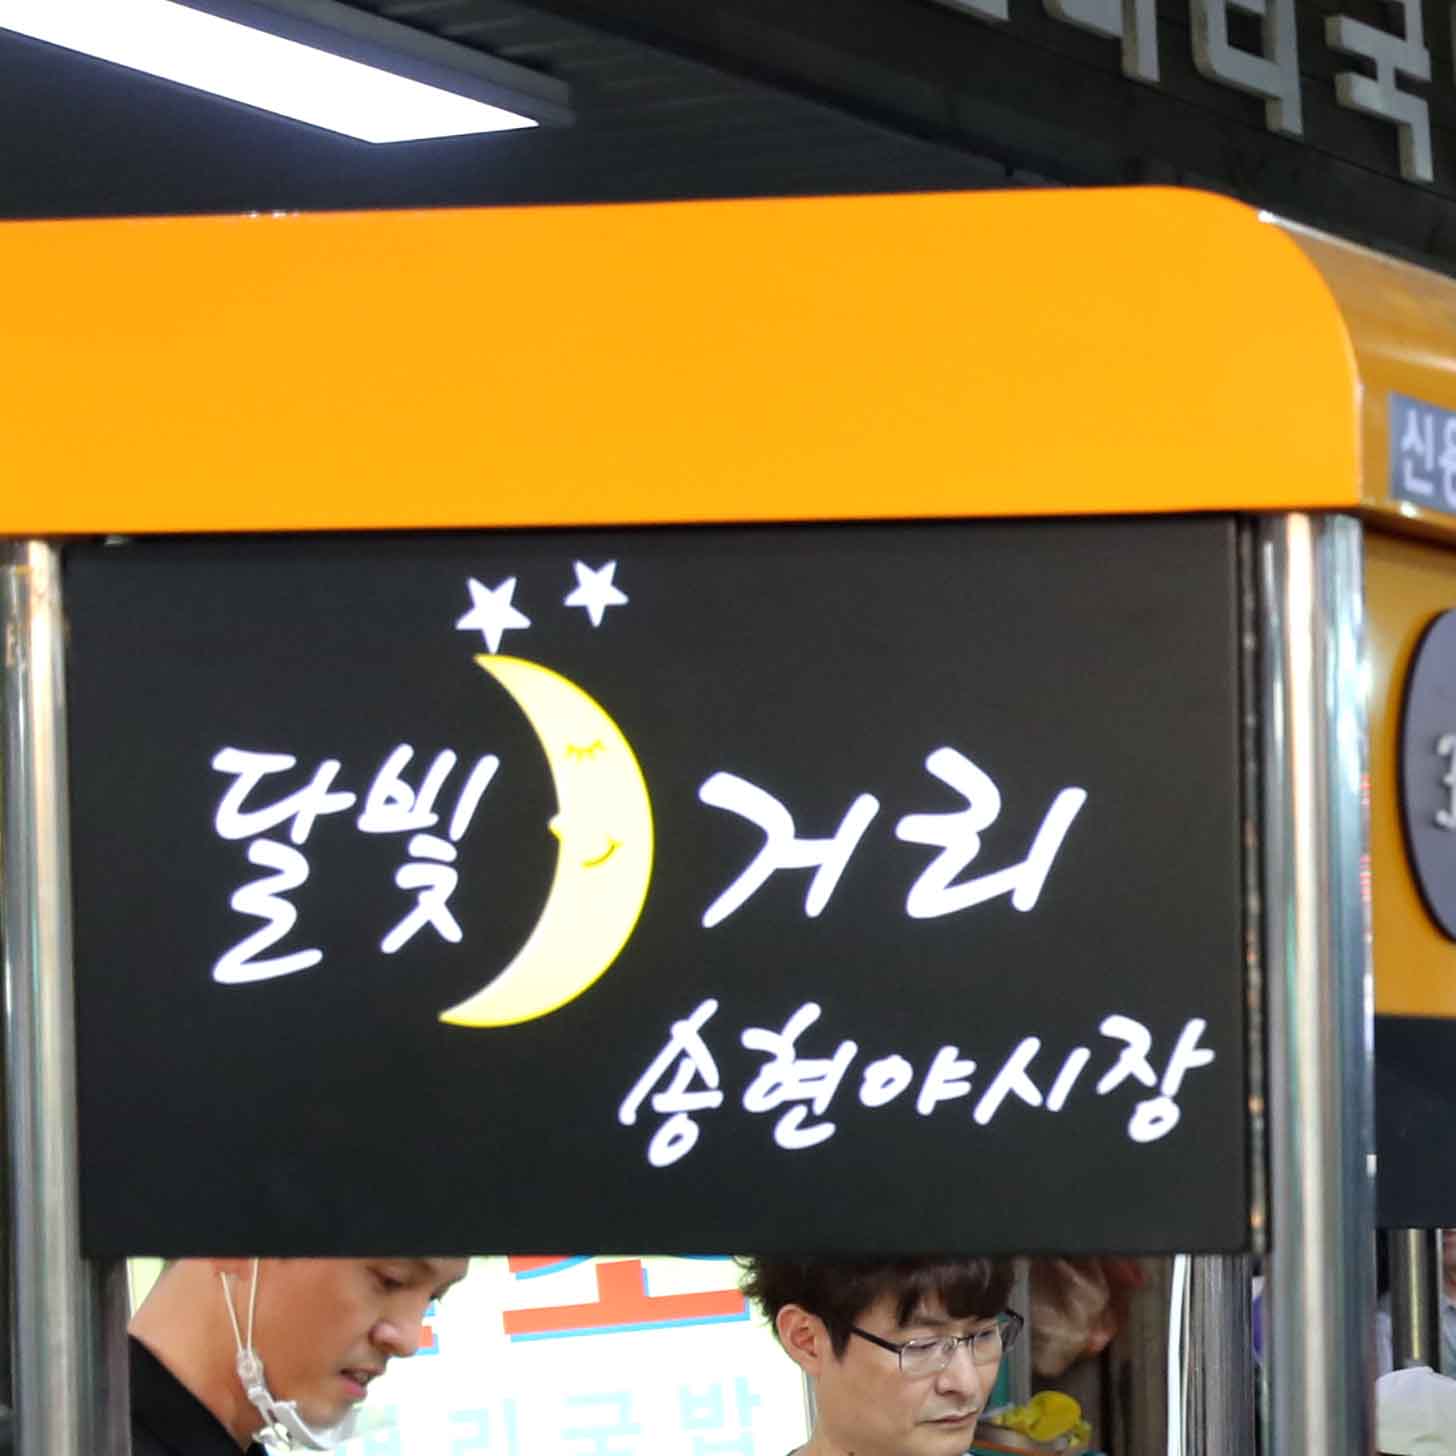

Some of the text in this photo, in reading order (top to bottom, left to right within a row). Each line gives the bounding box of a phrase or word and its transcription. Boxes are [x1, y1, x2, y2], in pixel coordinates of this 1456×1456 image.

[211, 744, 1088, 984] 달빛 거리
[619, 999, 1215, 1169] 송현야시장
